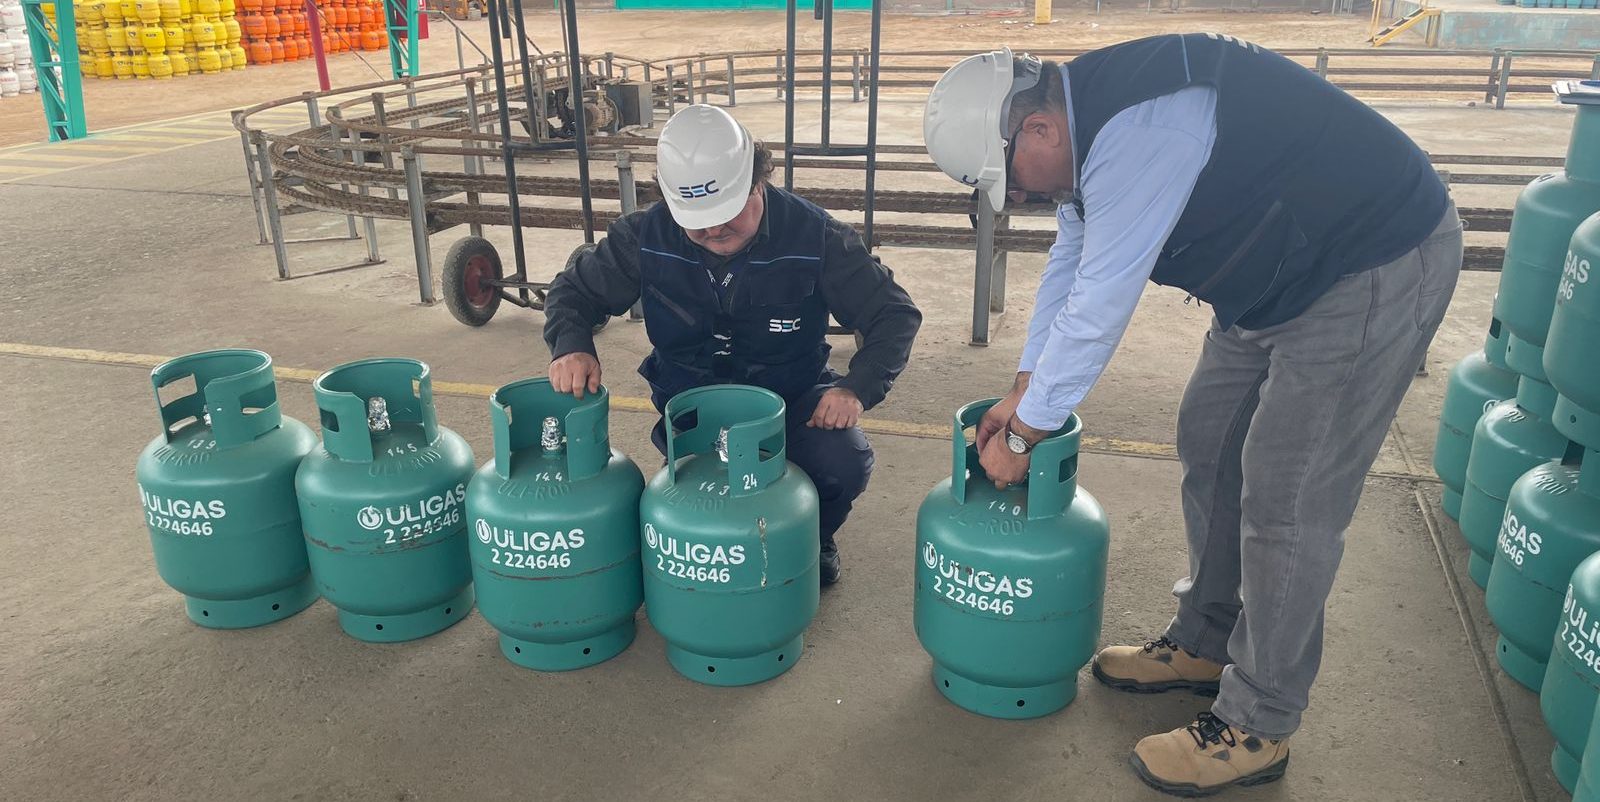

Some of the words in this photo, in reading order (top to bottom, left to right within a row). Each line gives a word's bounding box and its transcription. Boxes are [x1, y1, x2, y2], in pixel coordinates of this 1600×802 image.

[678, 179, 720, 199] SEC
[768, 317, 801, 333] SEC
[742, 472, 758, 490] 24
[145, 490, 227, 520] ULIGAS
[385, 482, 467, 526] ULIGAS
[383, 528, 397, 544] 2
[493, 525, 586, 552] ULIGAS
[658, 532, 746, 566] ULIGAS
[490, 547, 502, 565] 2
[503, 551, 572, 570] 224646
[656, 553, 666, 572] 2
[667, 559, 731, 584] 224646
[939, 553, 1034, 599] ULIGAS
[932, 574, 943, 594] 2
[944, 582, 1015, 616] 224646
[1561, 621, 1570, 642] 2
